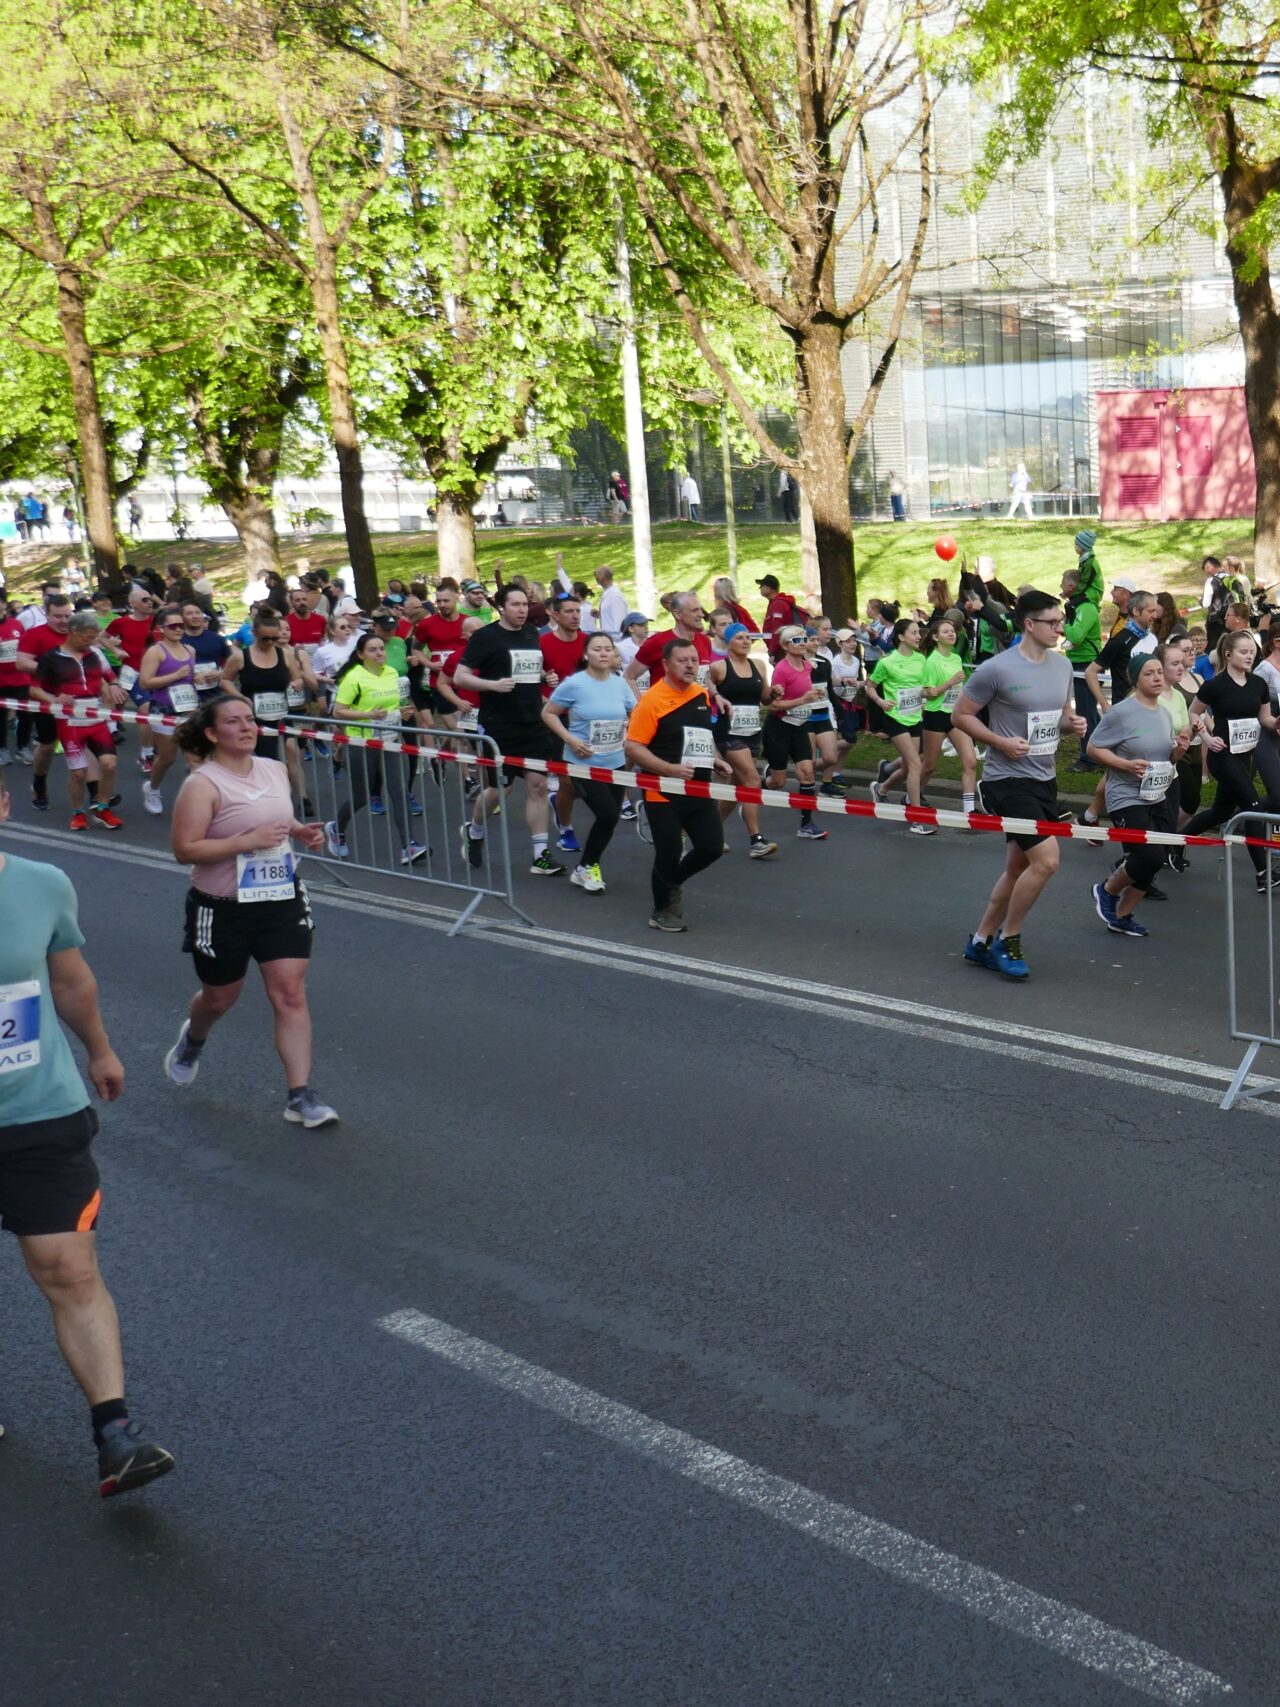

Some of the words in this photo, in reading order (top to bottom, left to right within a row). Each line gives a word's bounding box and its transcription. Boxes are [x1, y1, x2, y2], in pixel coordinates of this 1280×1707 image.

[1234, 730, 1257, 741] 16740
[690, 742, 713, 753] 15015
[280, 888, 294, 897] AG
